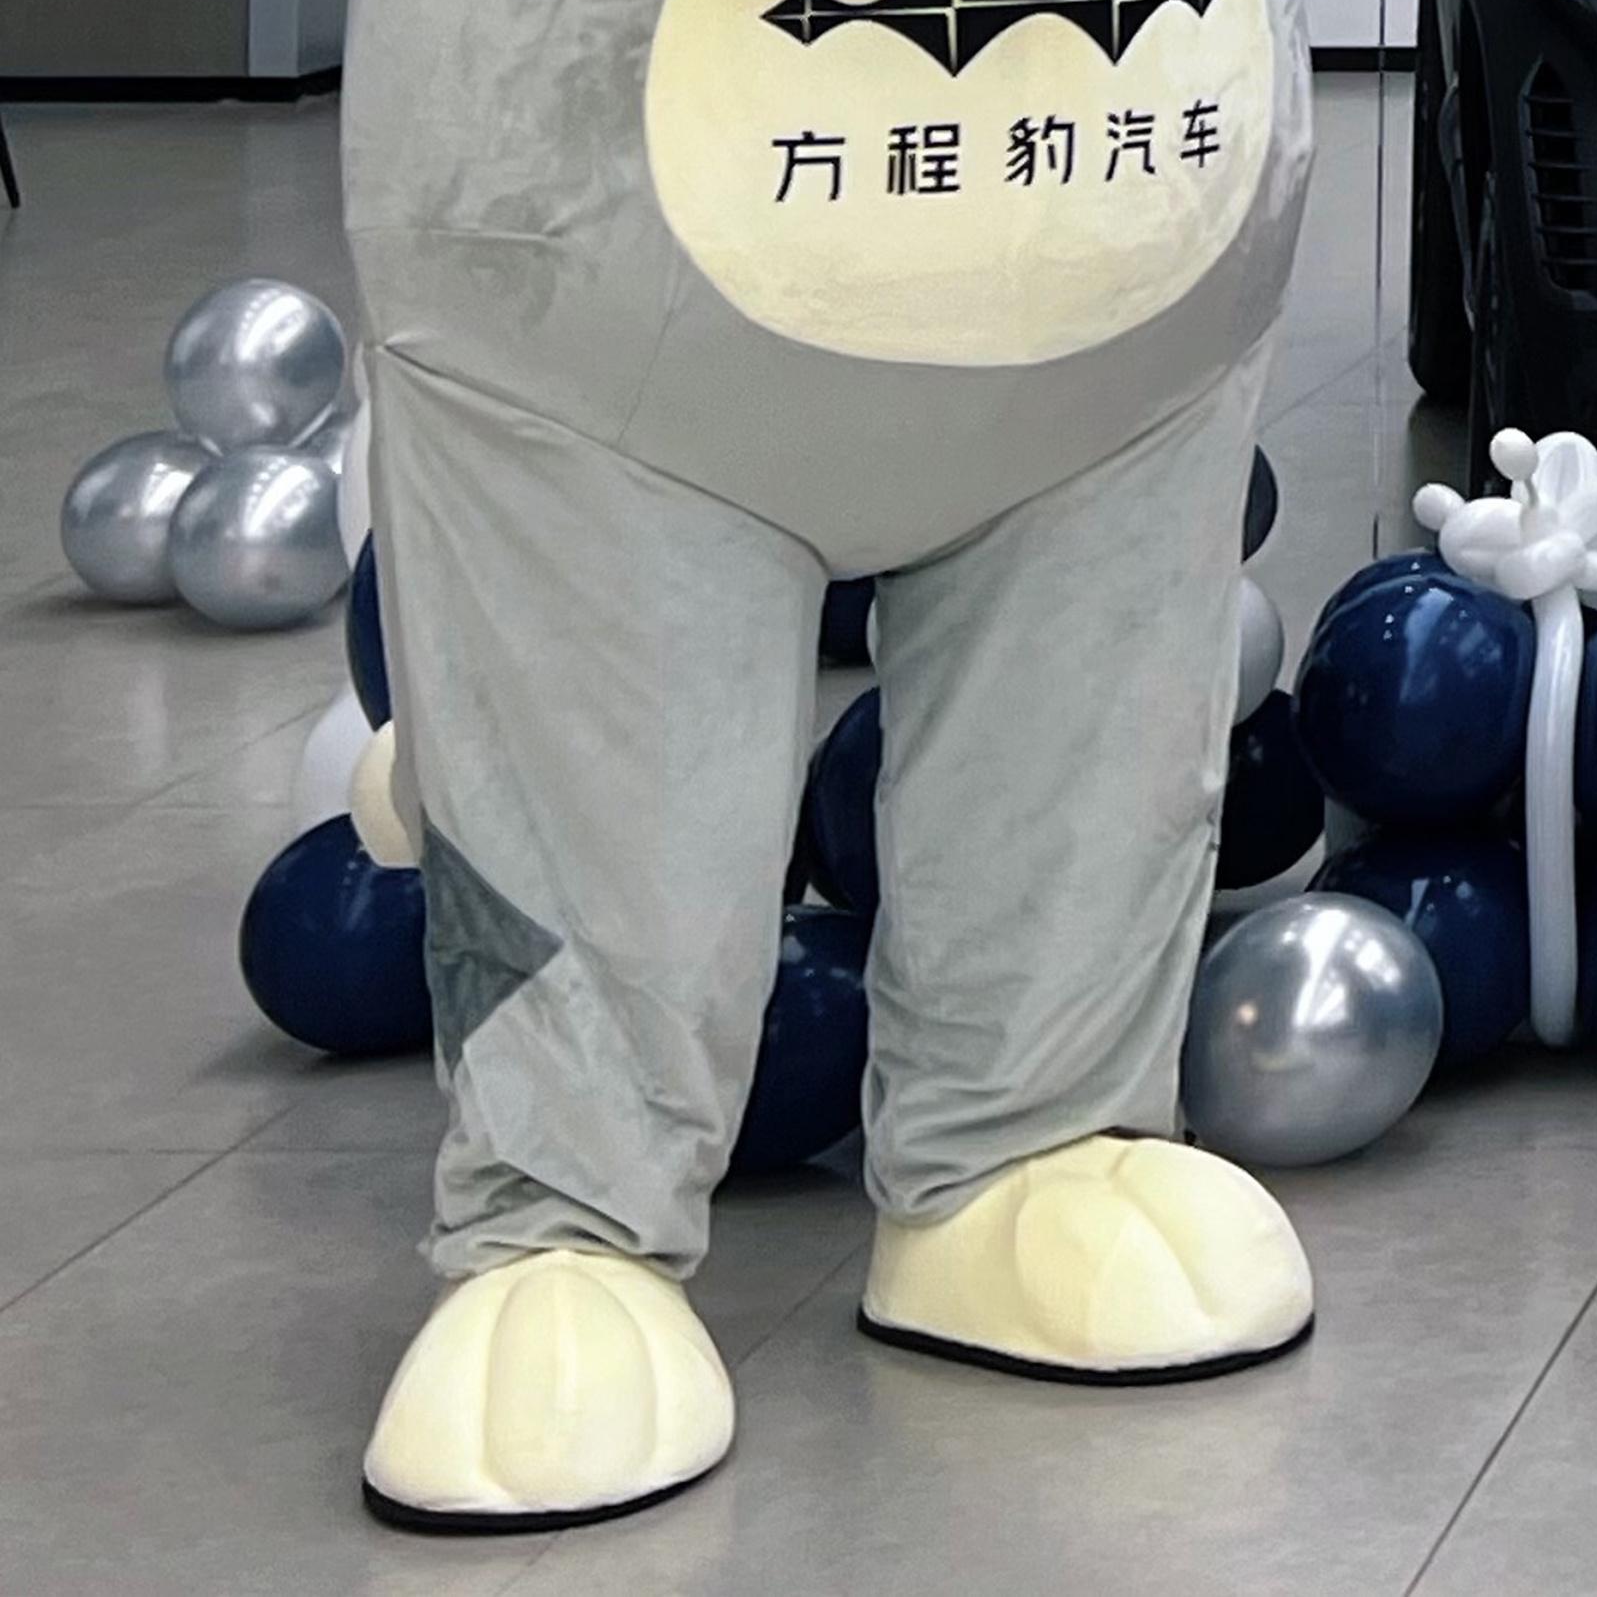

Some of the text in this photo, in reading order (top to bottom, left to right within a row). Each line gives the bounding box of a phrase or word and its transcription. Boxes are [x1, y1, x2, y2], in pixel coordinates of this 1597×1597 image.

[771, 99, 1221, 202] 方程豹汽车
